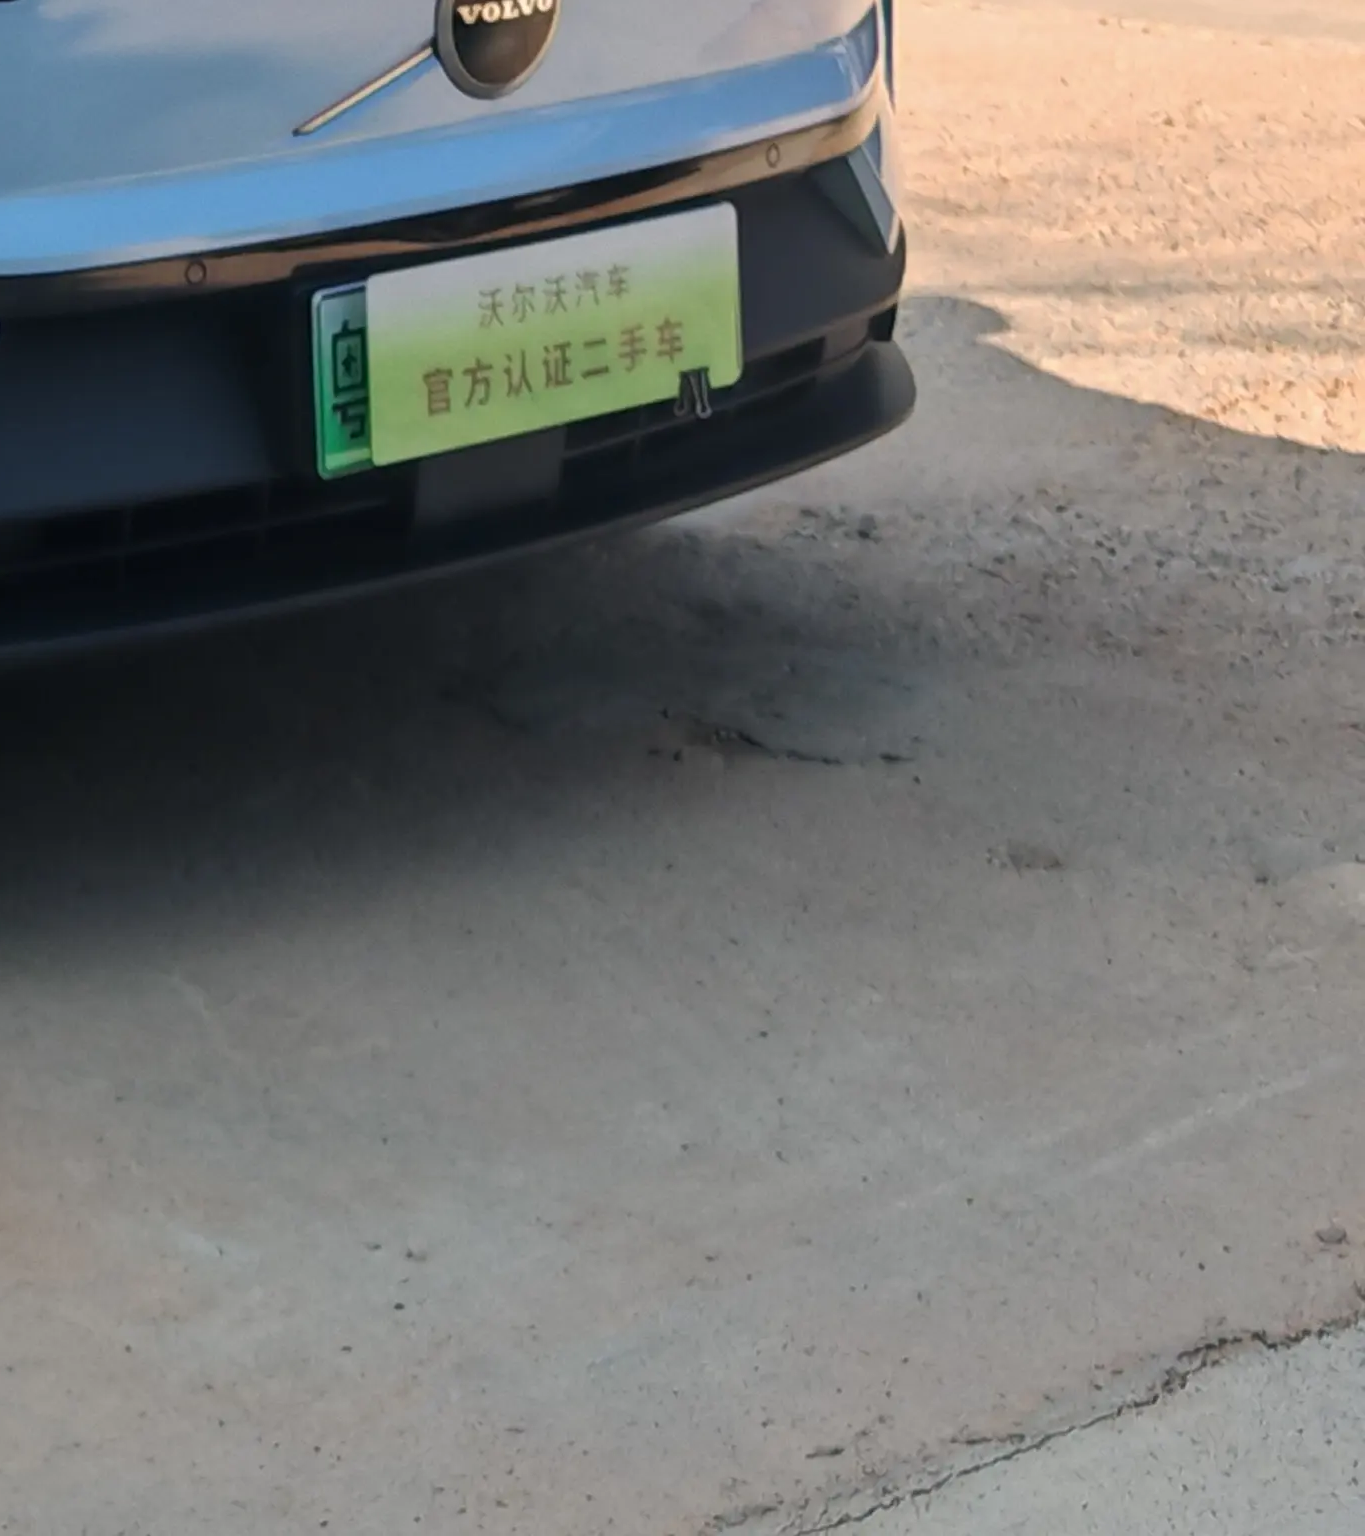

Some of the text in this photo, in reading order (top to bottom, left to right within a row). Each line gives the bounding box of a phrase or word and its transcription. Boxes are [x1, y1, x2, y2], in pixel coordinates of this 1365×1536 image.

[478, 264, 629, 328] 沃尔沃汽车
[422, 316, 684, 416] 官方认证二手车
